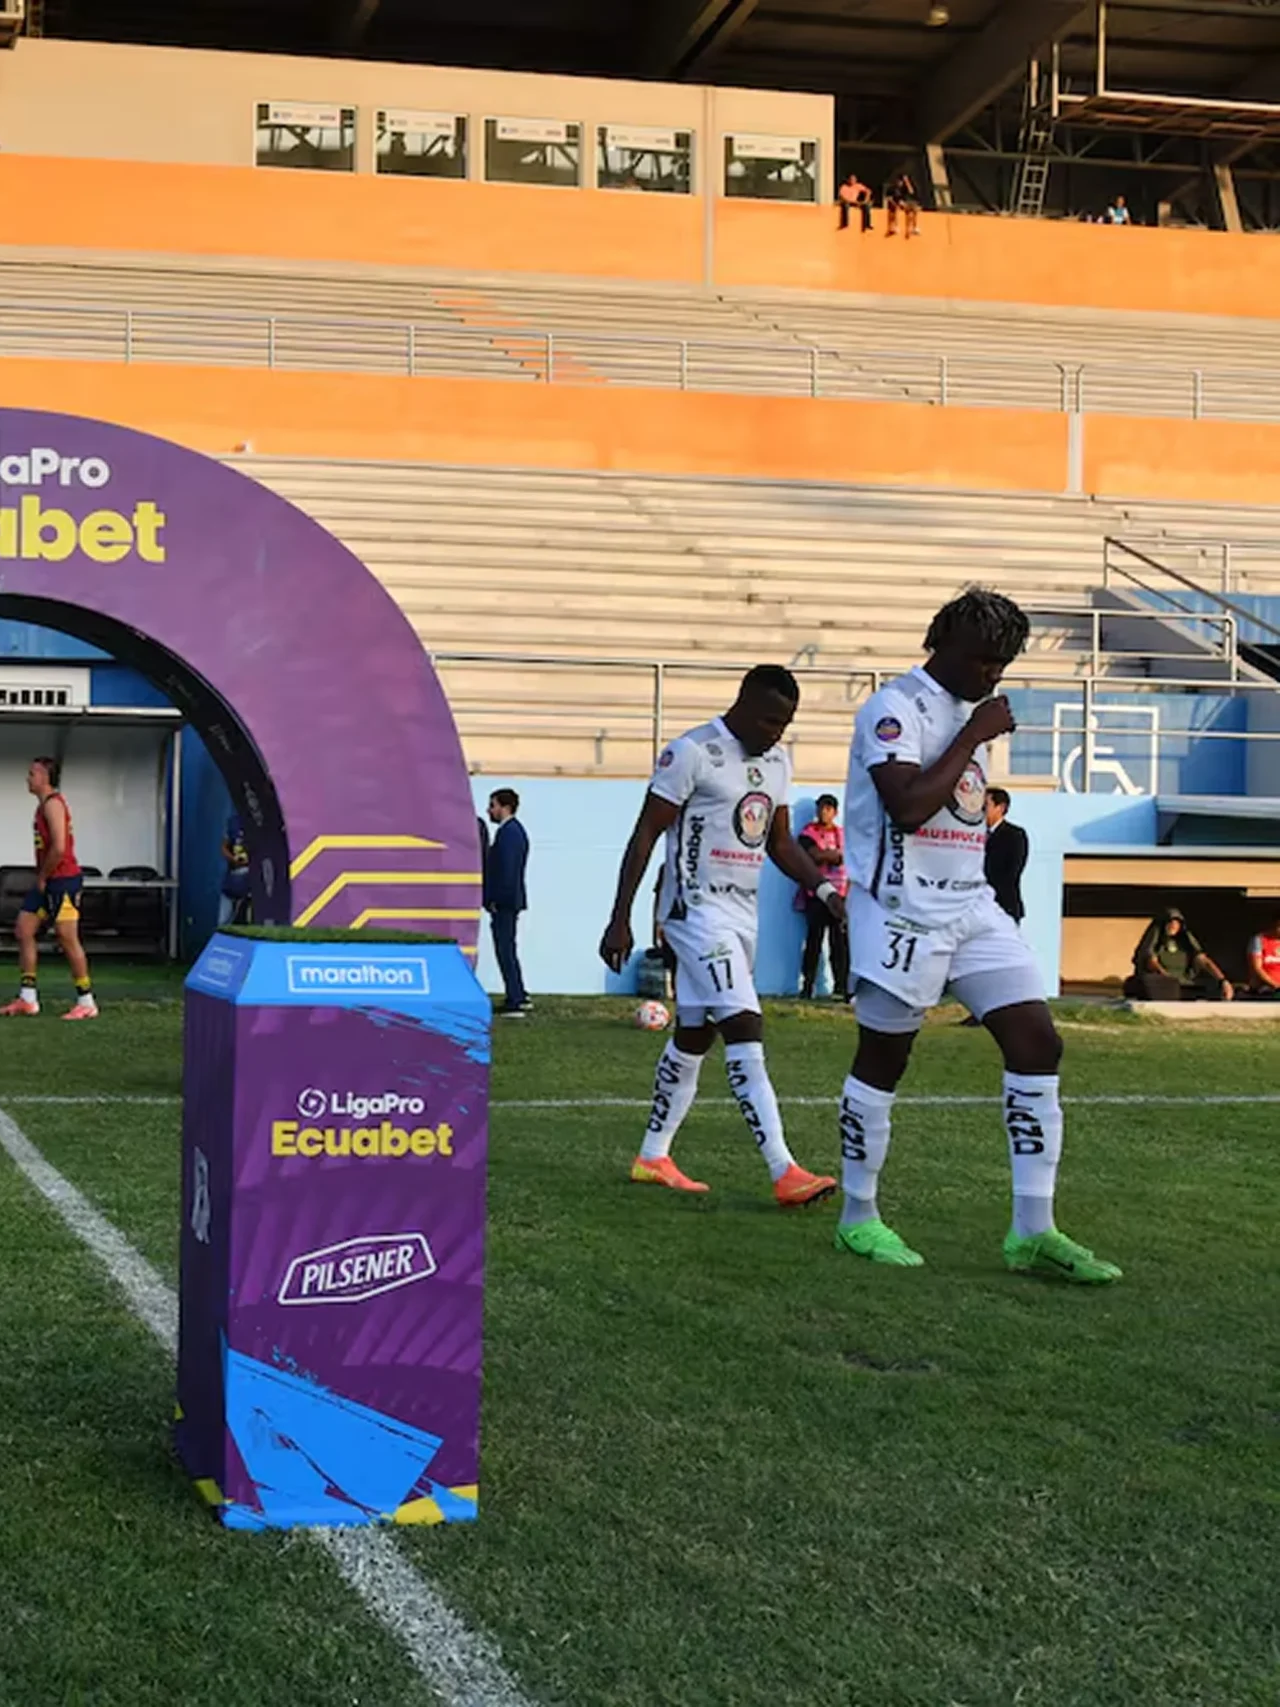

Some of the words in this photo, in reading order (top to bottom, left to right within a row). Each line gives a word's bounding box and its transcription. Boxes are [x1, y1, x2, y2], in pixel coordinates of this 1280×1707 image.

[881, 930, 917, 973] 31
[300, 964, 414, 985] marathon
[706, 957, 734, 992] 17
[331, 1092, 425, 1119] LigaPro
[271, 1121, 454, 1157] Ecuabet
[301, 1245, 415, 1295] PILSENER
